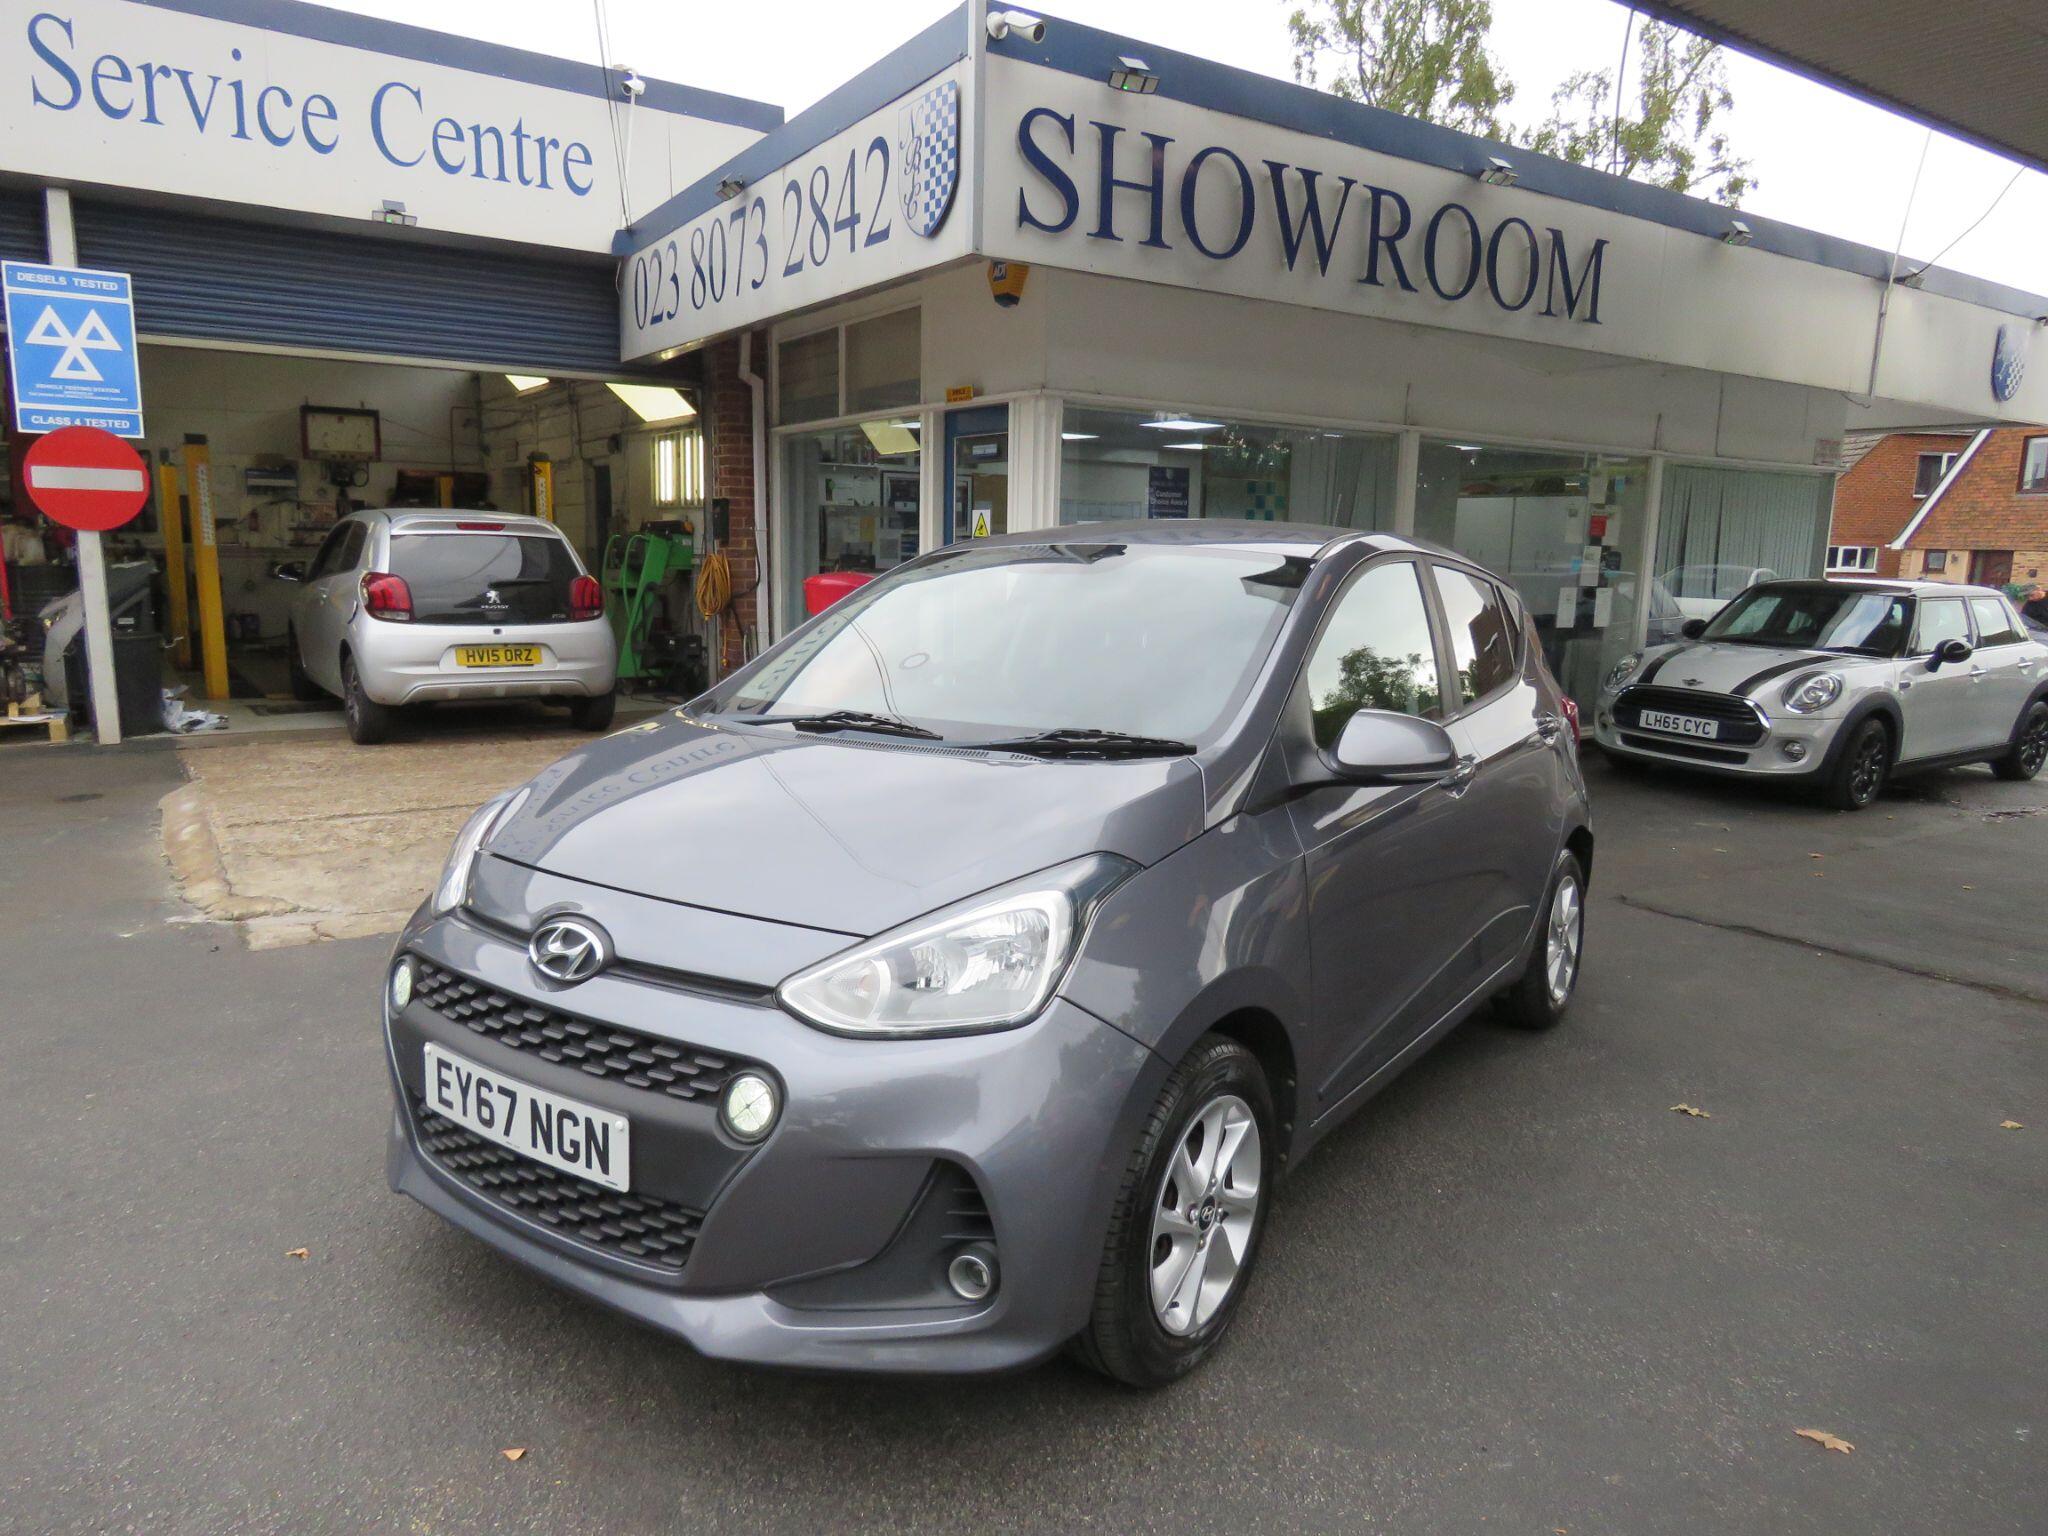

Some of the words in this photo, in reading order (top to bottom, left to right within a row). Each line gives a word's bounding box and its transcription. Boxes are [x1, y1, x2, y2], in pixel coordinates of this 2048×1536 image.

[26, 12, 339, 155] Service
[370, 81, 595, 197] Centre
[634, 239, 681, 331] 023
[689, 195, 770, 311] 8073
[781, 135, 893, 279] 2842
[1017, 106, 1611, 326] SHOWROOM
[16, 271, 68, 286] DIESELS
[72, 277, 119, 292] TESTED
[30, 415, 72, 426] CLASS
[74, 418, 82, 426] 4
[84, 418, 130, 429] TESTED
[465, 648, 501, 663] HV15
[504, 648, 534, 662] ORZ
[1645, 712, 1680, 730] LH65
[1683, 718, 1712, 735] CYC
[436, 1056, 518, 1138] EY67
[530, 1097, 610, 1176] NGN
